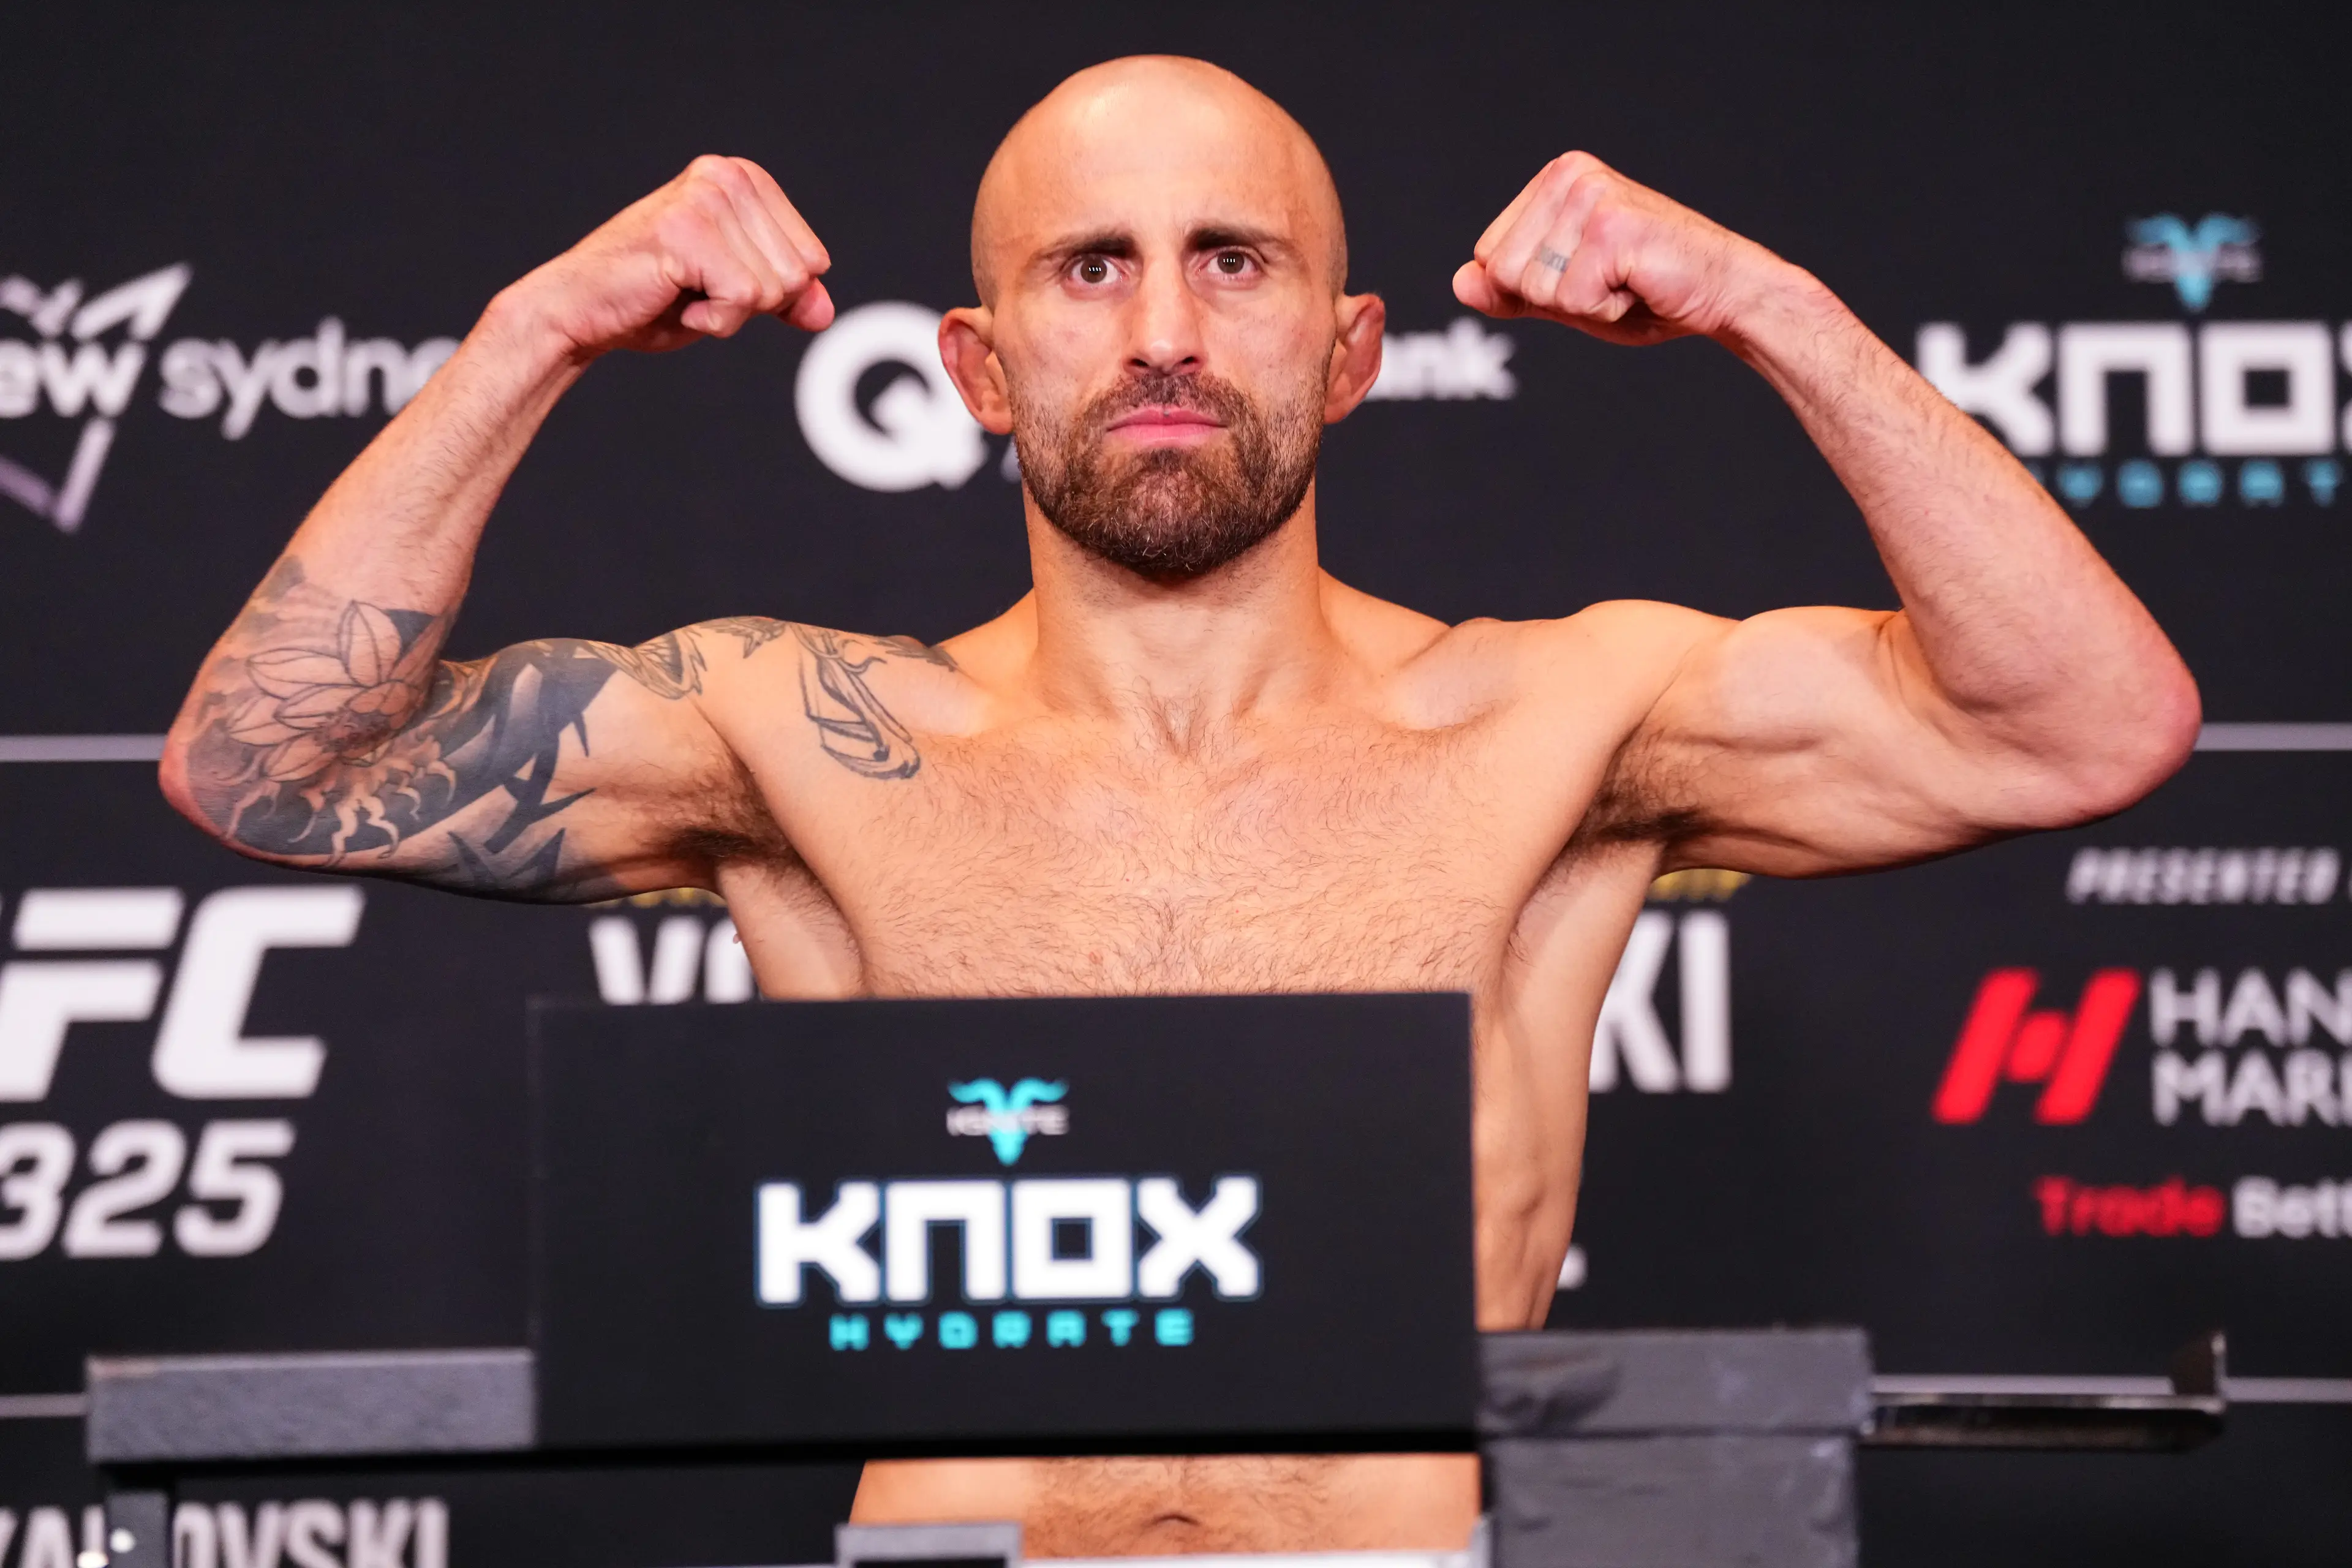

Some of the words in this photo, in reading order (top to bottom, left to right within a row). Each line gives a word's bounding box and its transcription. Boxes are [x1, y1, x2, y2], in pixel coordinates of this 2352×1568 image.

[0, 1120, 296, 1261] 325
[755, 1175, 1262, 1305] KNOX
[829, 1308, 1194, 1351] HYDRATE
